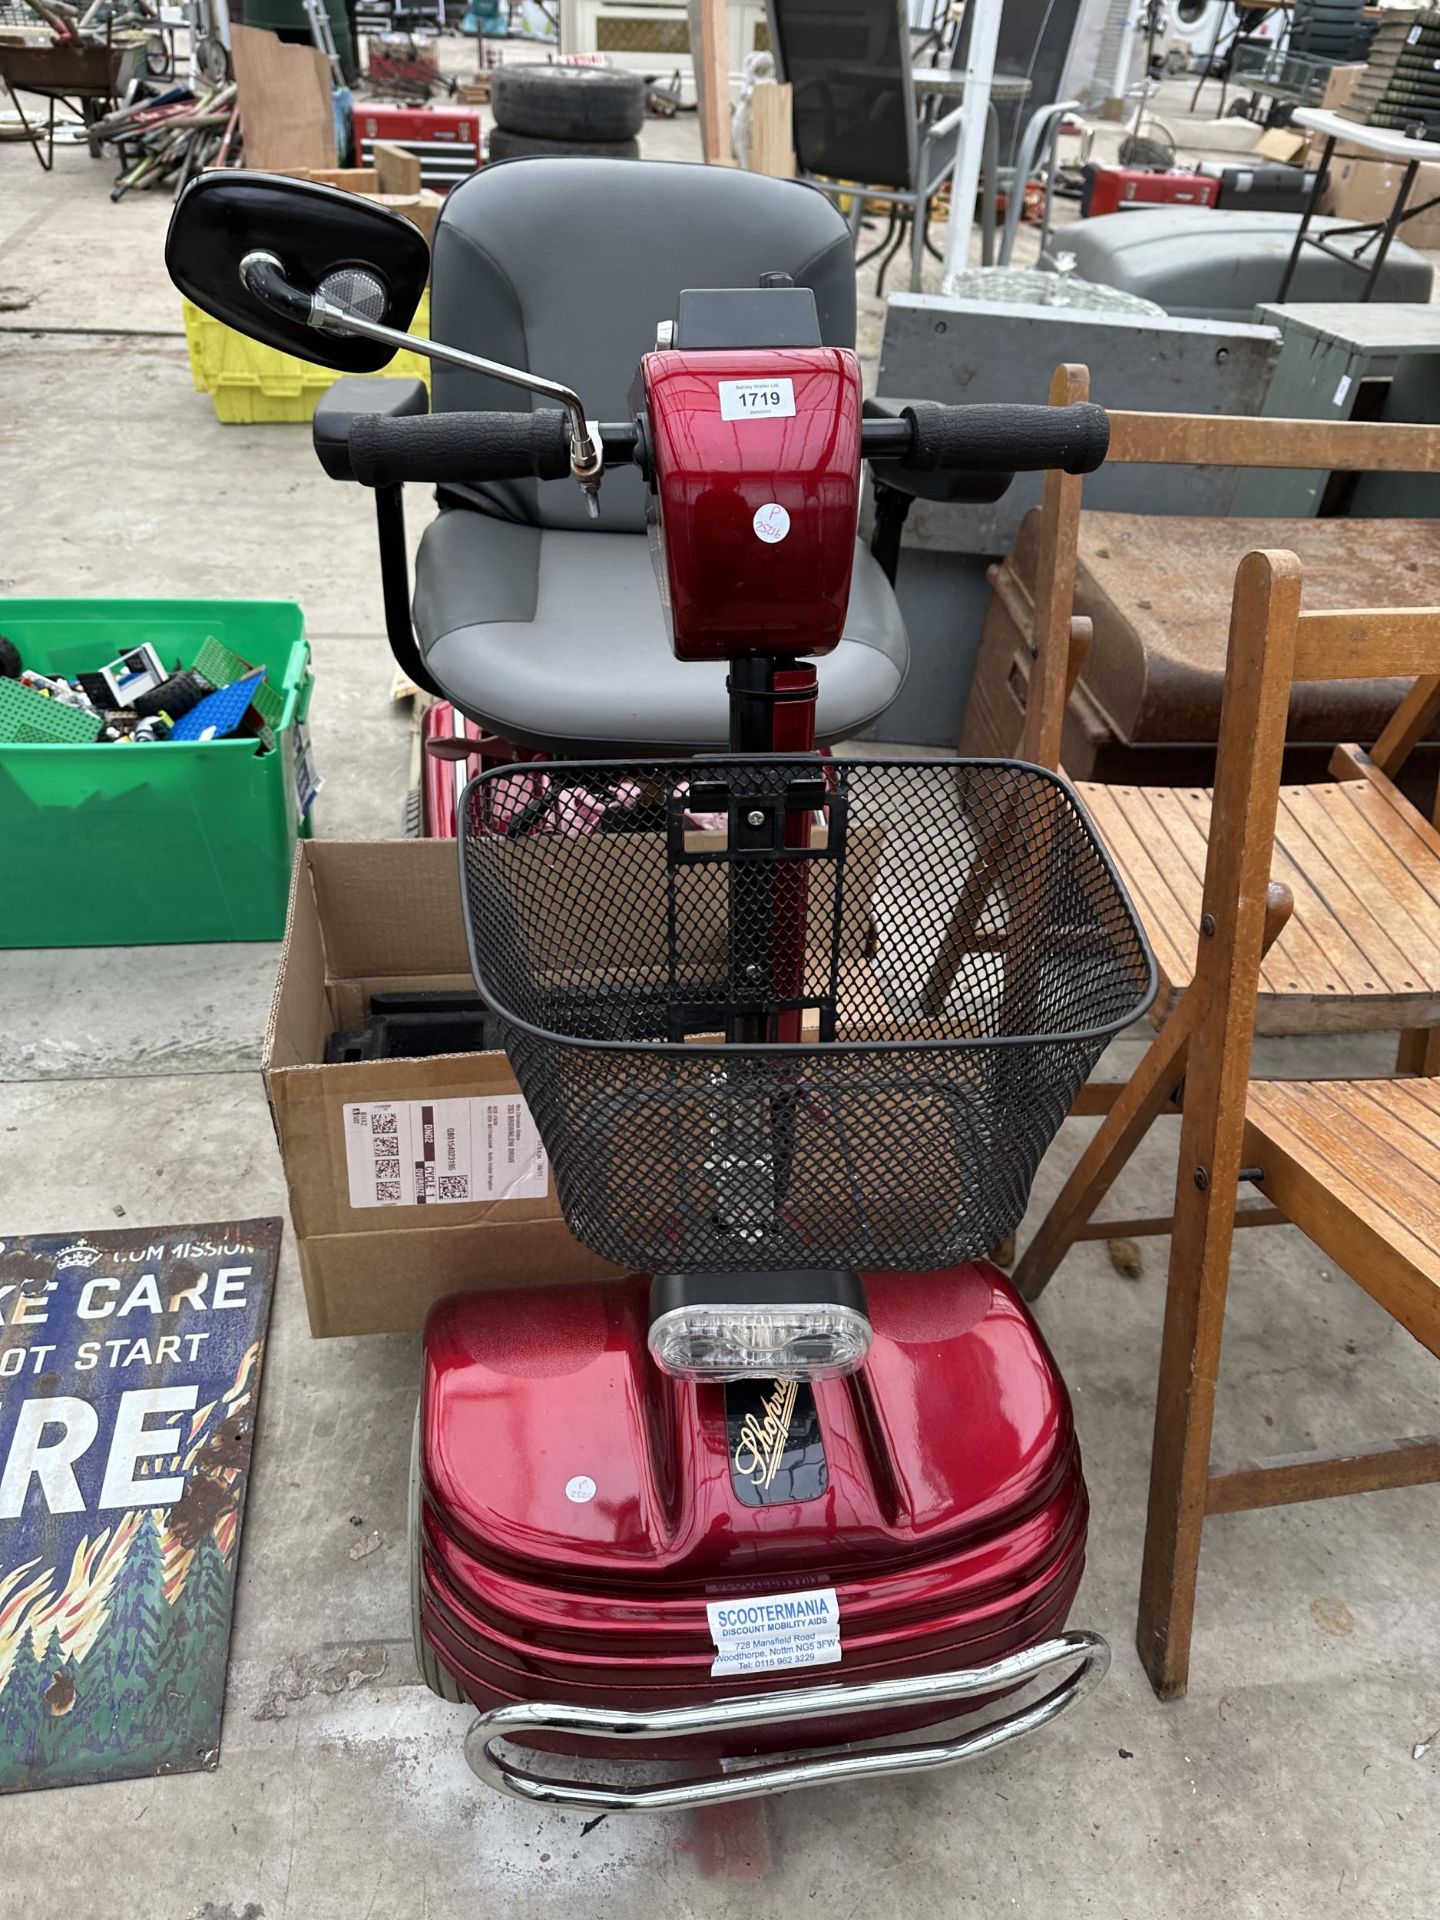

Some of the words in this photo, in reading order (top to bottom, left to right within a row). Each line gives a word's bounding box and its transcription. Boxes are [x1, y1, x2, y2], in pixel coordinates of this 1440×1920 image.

[739, 391, 780, 407] 1719
[424, 1124, 433, 1143] DNG2
[415, 1168, 425, 1197] OVERSIZE
[425, 1165, 435, 1189] CYCLE
[77, 1266, 252, 1320] CARE
[75, 1333, 209, 1370] START
[718, 1598, 829, 1627] SCOOTERMANIA
[722, 1625, 765, 1637] DISCOUNT
[767, 1621, 806, 1631] MOBILITY
[808, 1616, 828, 1625] AIDS
[735, 1642, 751, 1650] 728
[753, 1636, 792, 1648] Mansfield
[794, 1633, 816, 1642] Road
[769, 1647, 794, 1656] Nottm
[796, 1642, 815, 1652] NG5
[816, 1639, 836, 1650] 3FW
[738, 1662, 753, 1670] Tel:
[755, 1659, 775, 1668] 0115
